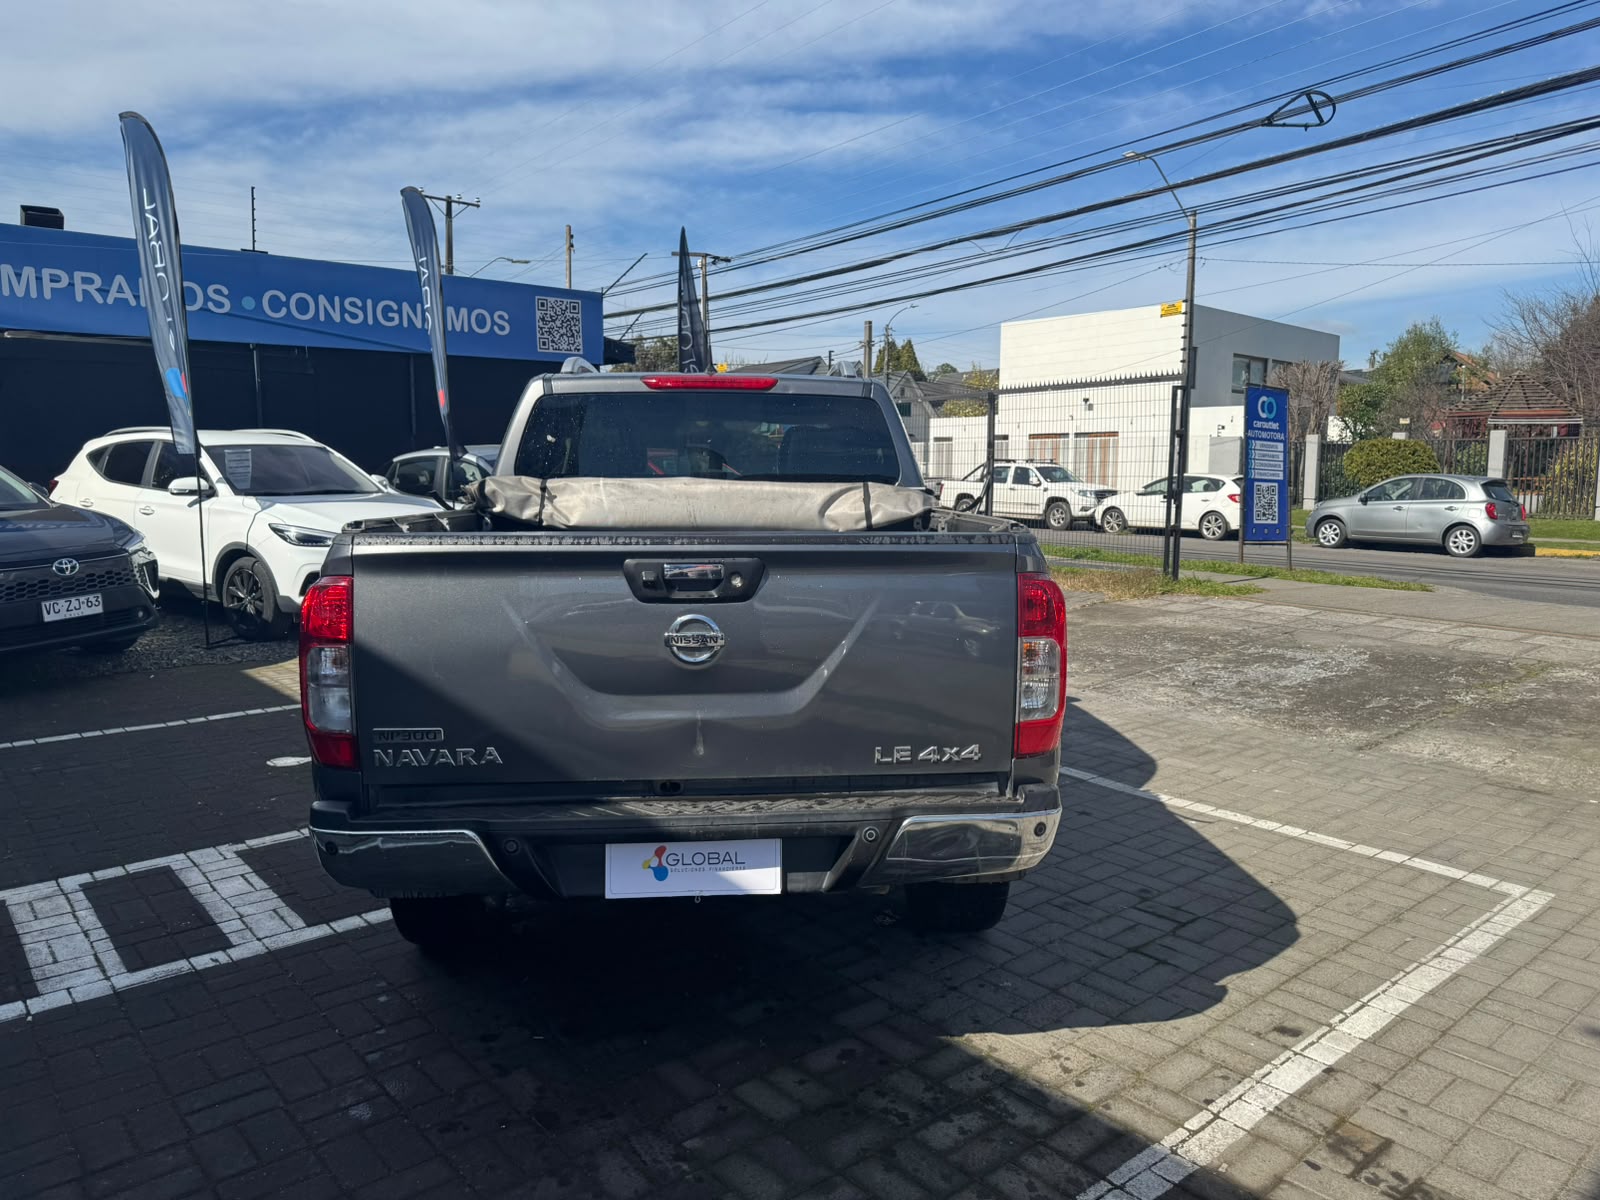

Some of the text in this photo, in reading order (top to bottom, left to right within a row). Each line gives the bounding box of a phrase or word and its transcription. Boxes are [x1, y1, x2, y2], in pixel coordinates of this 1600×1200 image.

[0, 264, 511, 336] MPRAOS CONSIGNMOS
[1253, 420, 1280, 430] caroutlet
[1247, 430, 1285, 440] AUTOMOTORA
[671, 634, 719, 645] NISSAN
[378, 730, 438, 742] NP300
[373, 746, 503, 767] NAVARA
[874, 745, 912, 764] LE
[665, 851, 746, 866] GLOBAL
